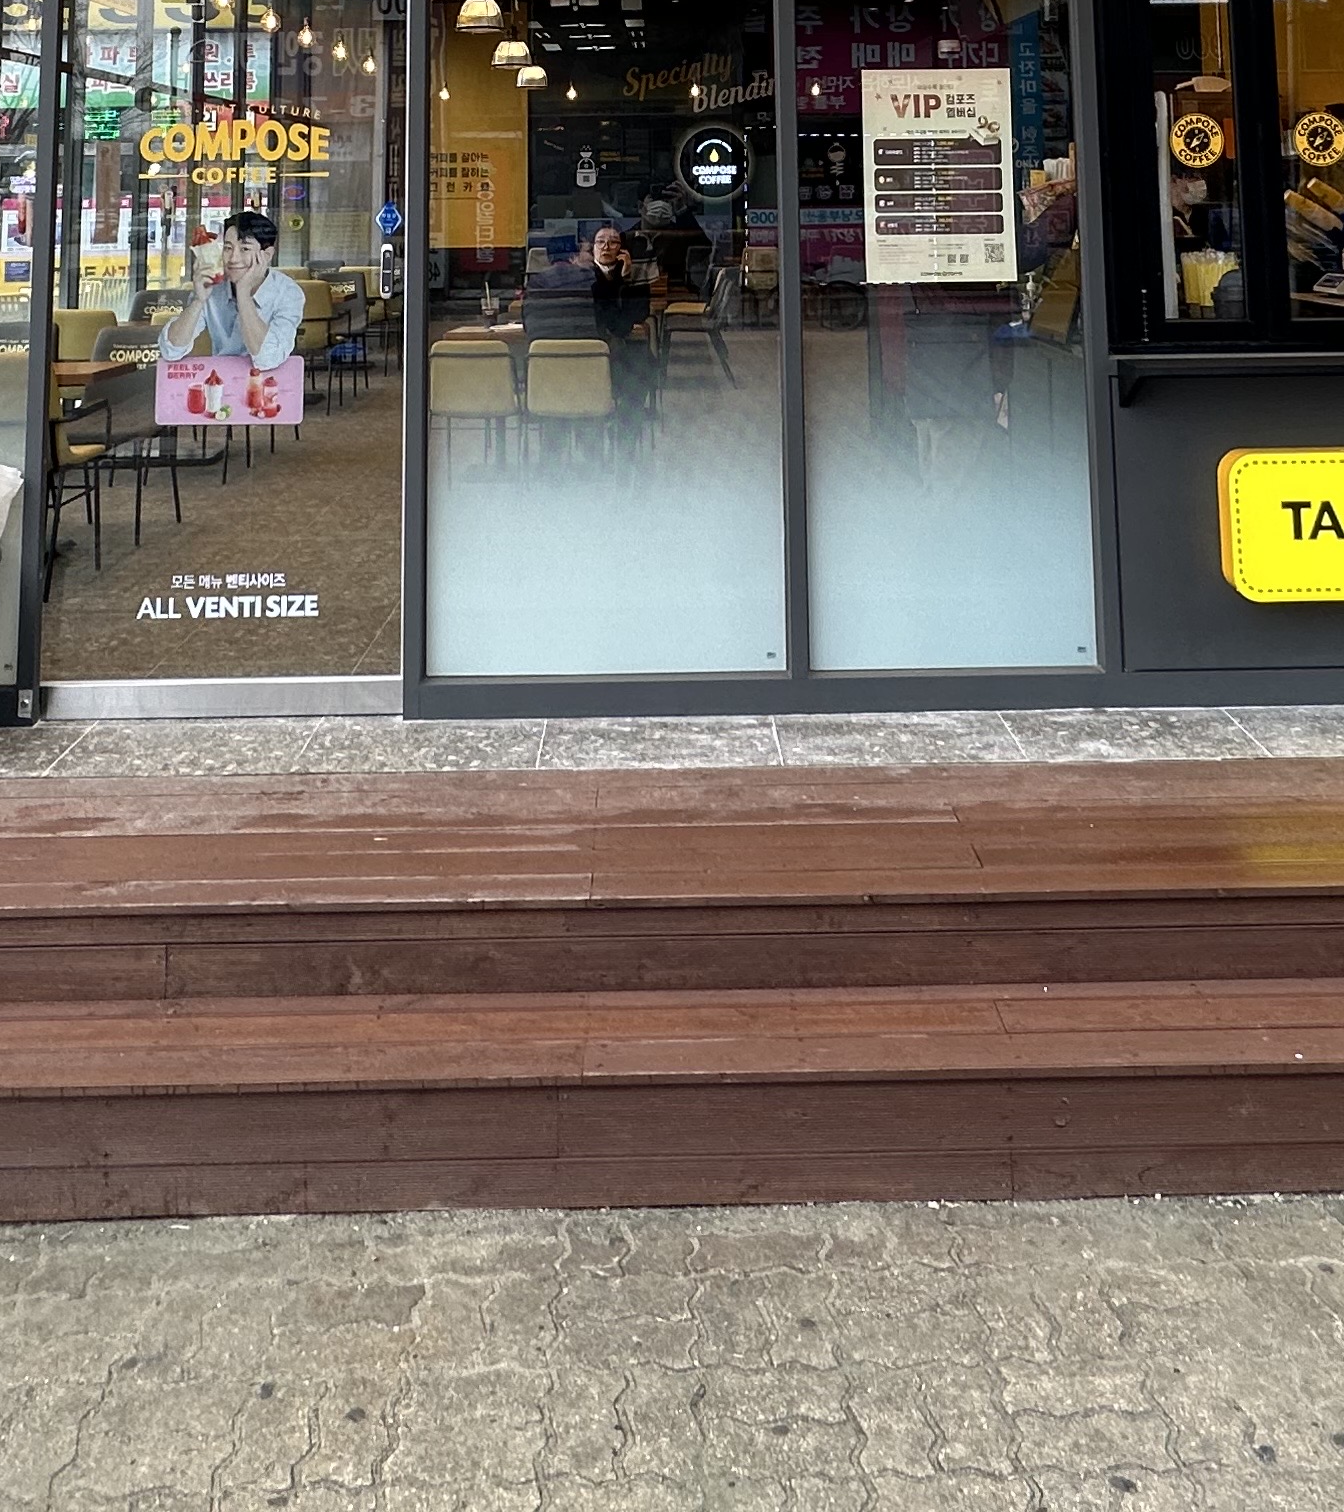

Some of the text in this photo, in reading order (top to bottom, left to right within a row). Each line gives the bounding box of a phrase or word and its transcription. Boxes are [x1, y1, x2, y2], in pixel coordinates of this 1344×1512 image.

[890, 93, 942, 119] VIP
[1173, 116, 1220, 139] COMPOSE
[1297, 115, 1344, 138] COMPOSE
[140, 119, 331, 163] COMPOSE
[1177, 147, 1218, 164] COFFEE
[1302, 146, 1342, 163] COFFEE
[191, 167, 278, 185] COFFEE
[171, 574, 196, 590] 모든
[225, 572, 287, 589] 벤티사이즈
[137, 594, 320, 620] ALL VENTI SIZE
